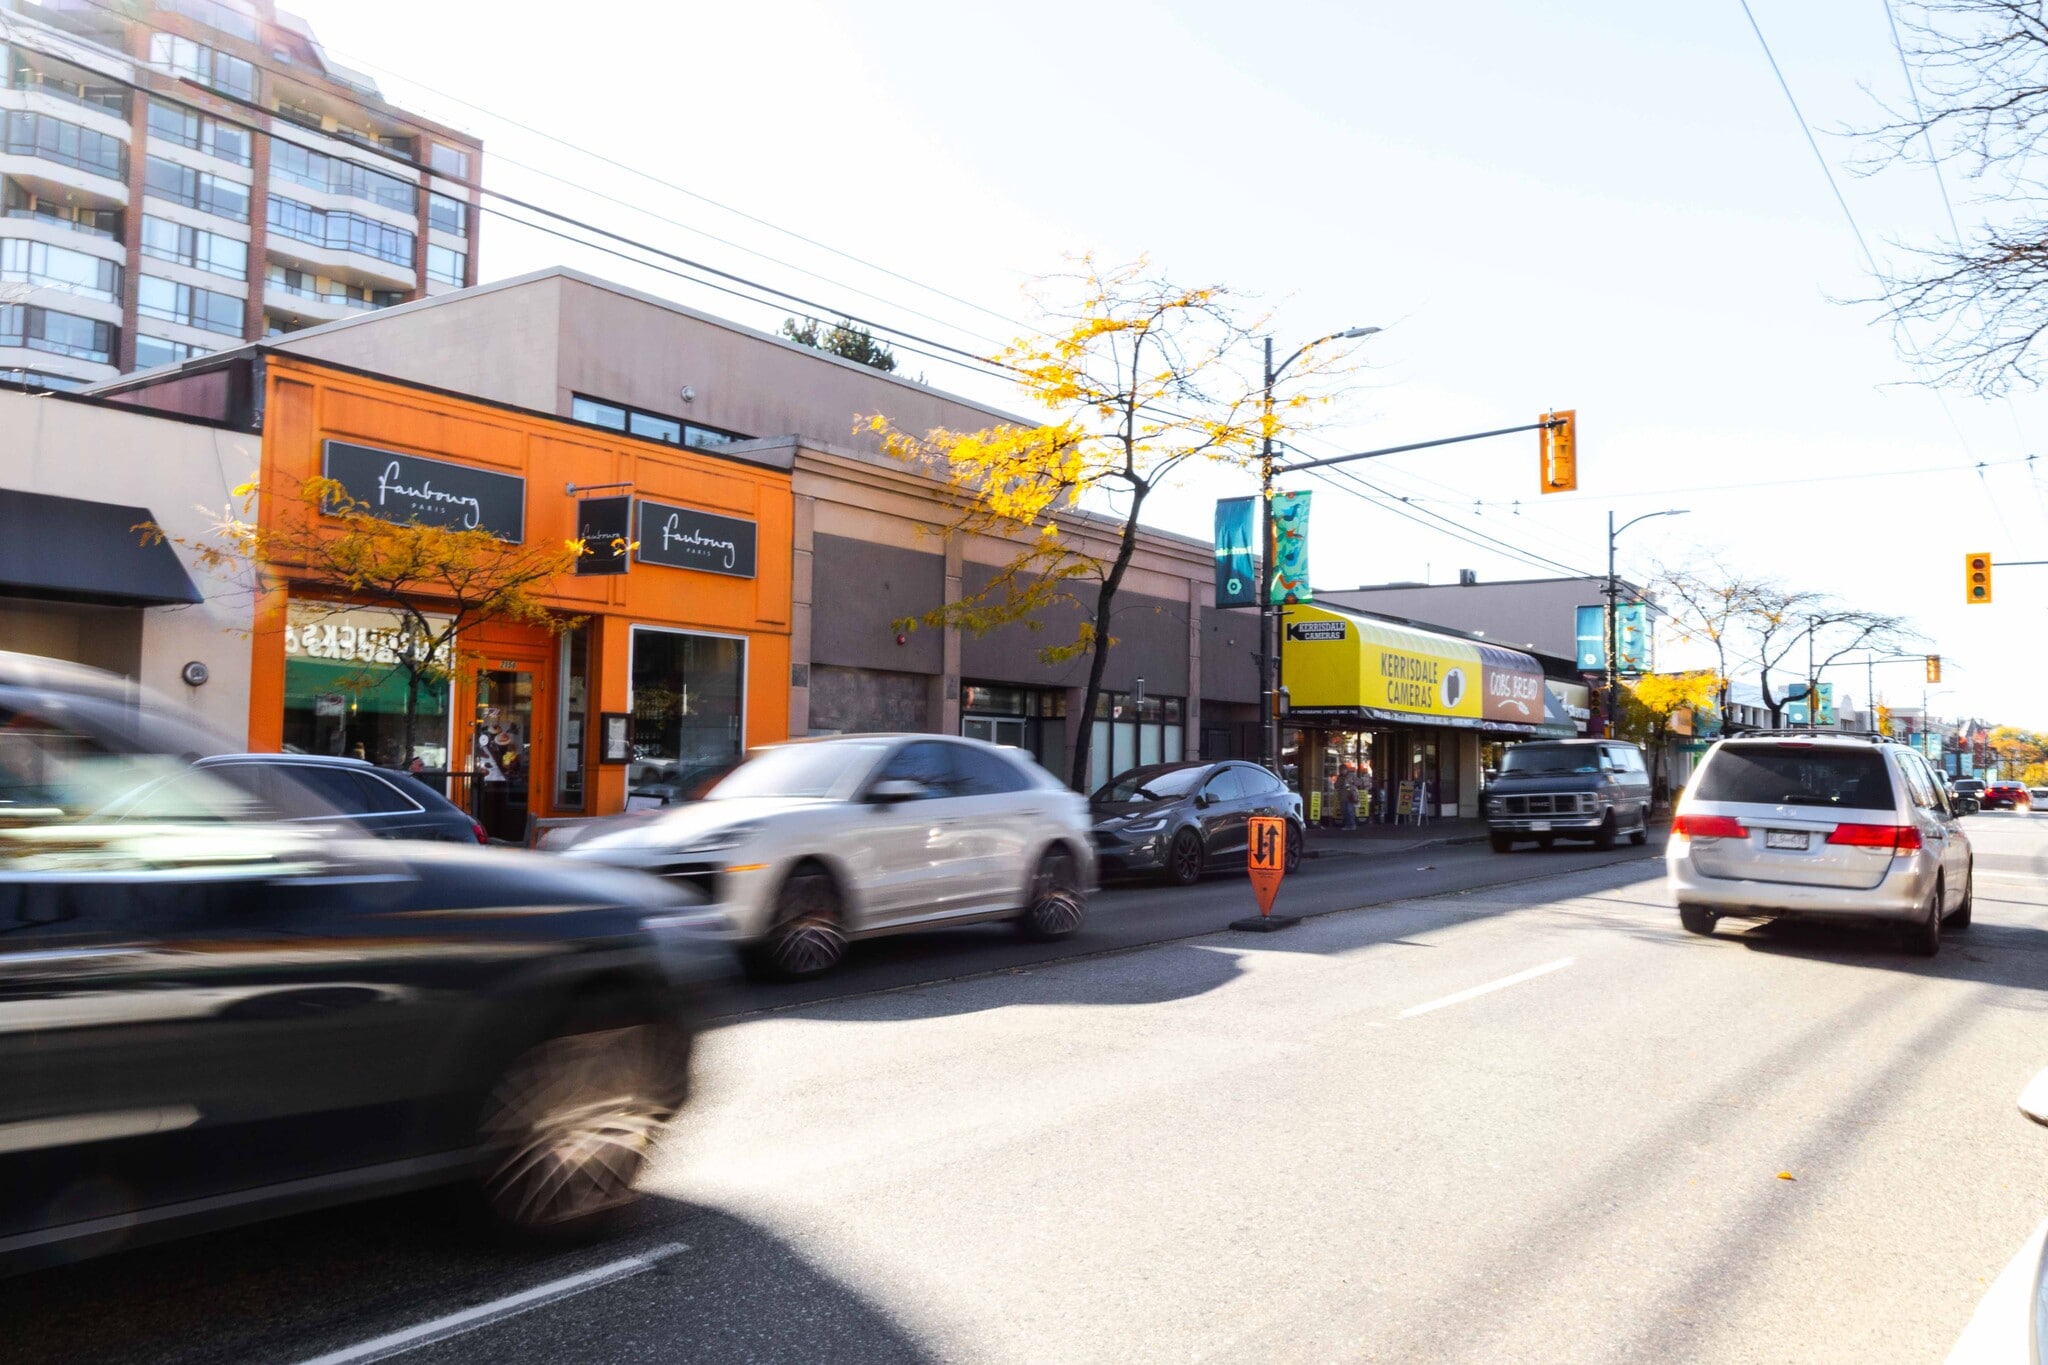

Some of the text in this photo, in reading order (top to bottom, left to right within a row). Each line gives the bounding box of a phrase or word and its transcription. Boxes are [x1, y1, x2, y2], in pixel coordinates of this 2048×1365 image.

[411, 502, 446, 514] PARIS
[686, 547, 711, 557] PARIS
[1299, 622, 1345, 632] KERRISDALE
[1304, 631, 1341, 640] CAMERAS
[1381, 652, 1438, 684] KERRISDALE
[1490, 671, 1538, 700] COBS BREAD
[1387, 680, 1433, 708] CAMERAS
